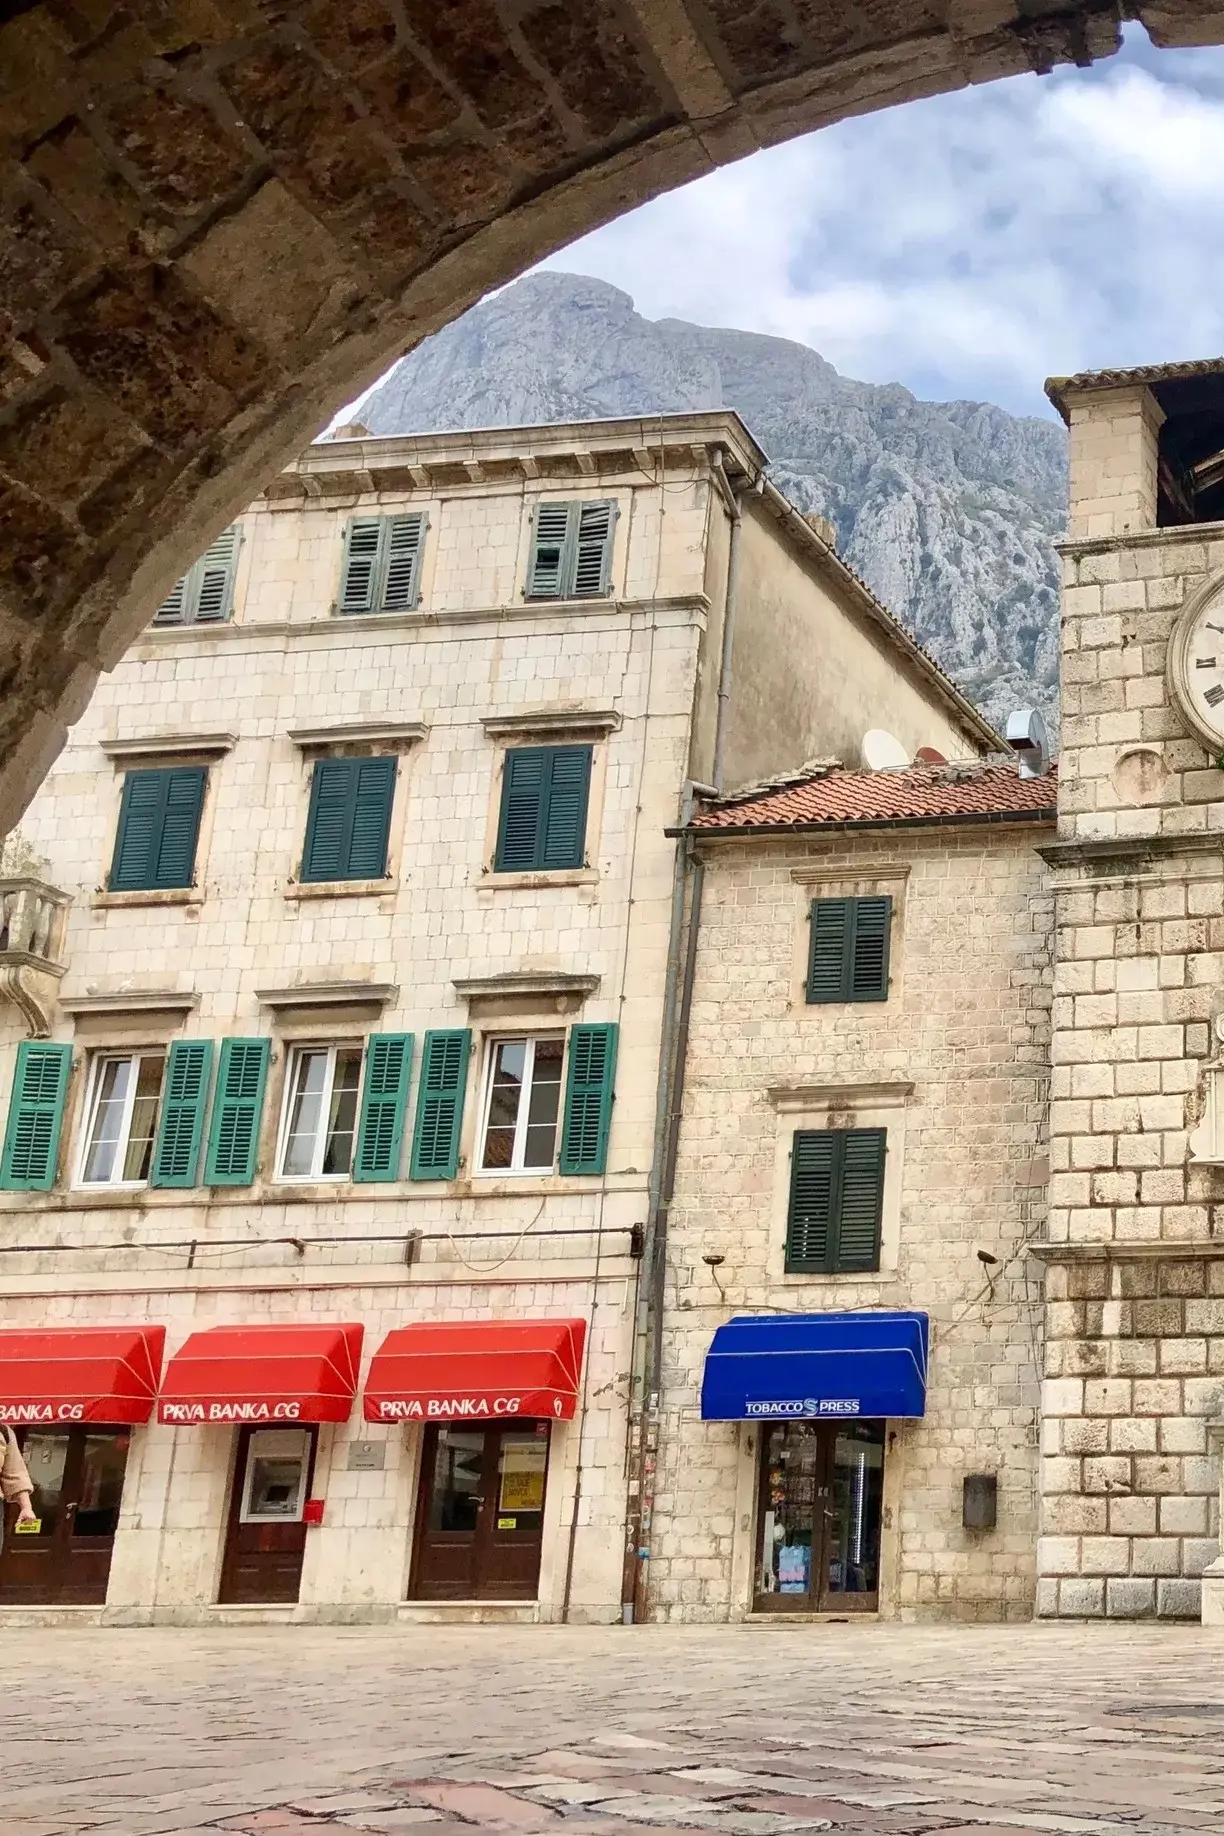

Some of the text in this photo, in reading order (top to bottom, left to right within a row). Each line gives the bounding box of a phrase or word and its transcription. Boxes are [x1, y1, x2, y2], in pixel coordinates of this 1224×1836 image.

[0, 1403, 84, 1420] BANKA CG
[163, 1401, 300, 1420] PRVA BANKA CG
[380, 1397, 521, 1417] PRVA BANKA CG
[746, 1402, 803, 1413] TOBACCO
[819, 1401, 860, 1411] PRESS
